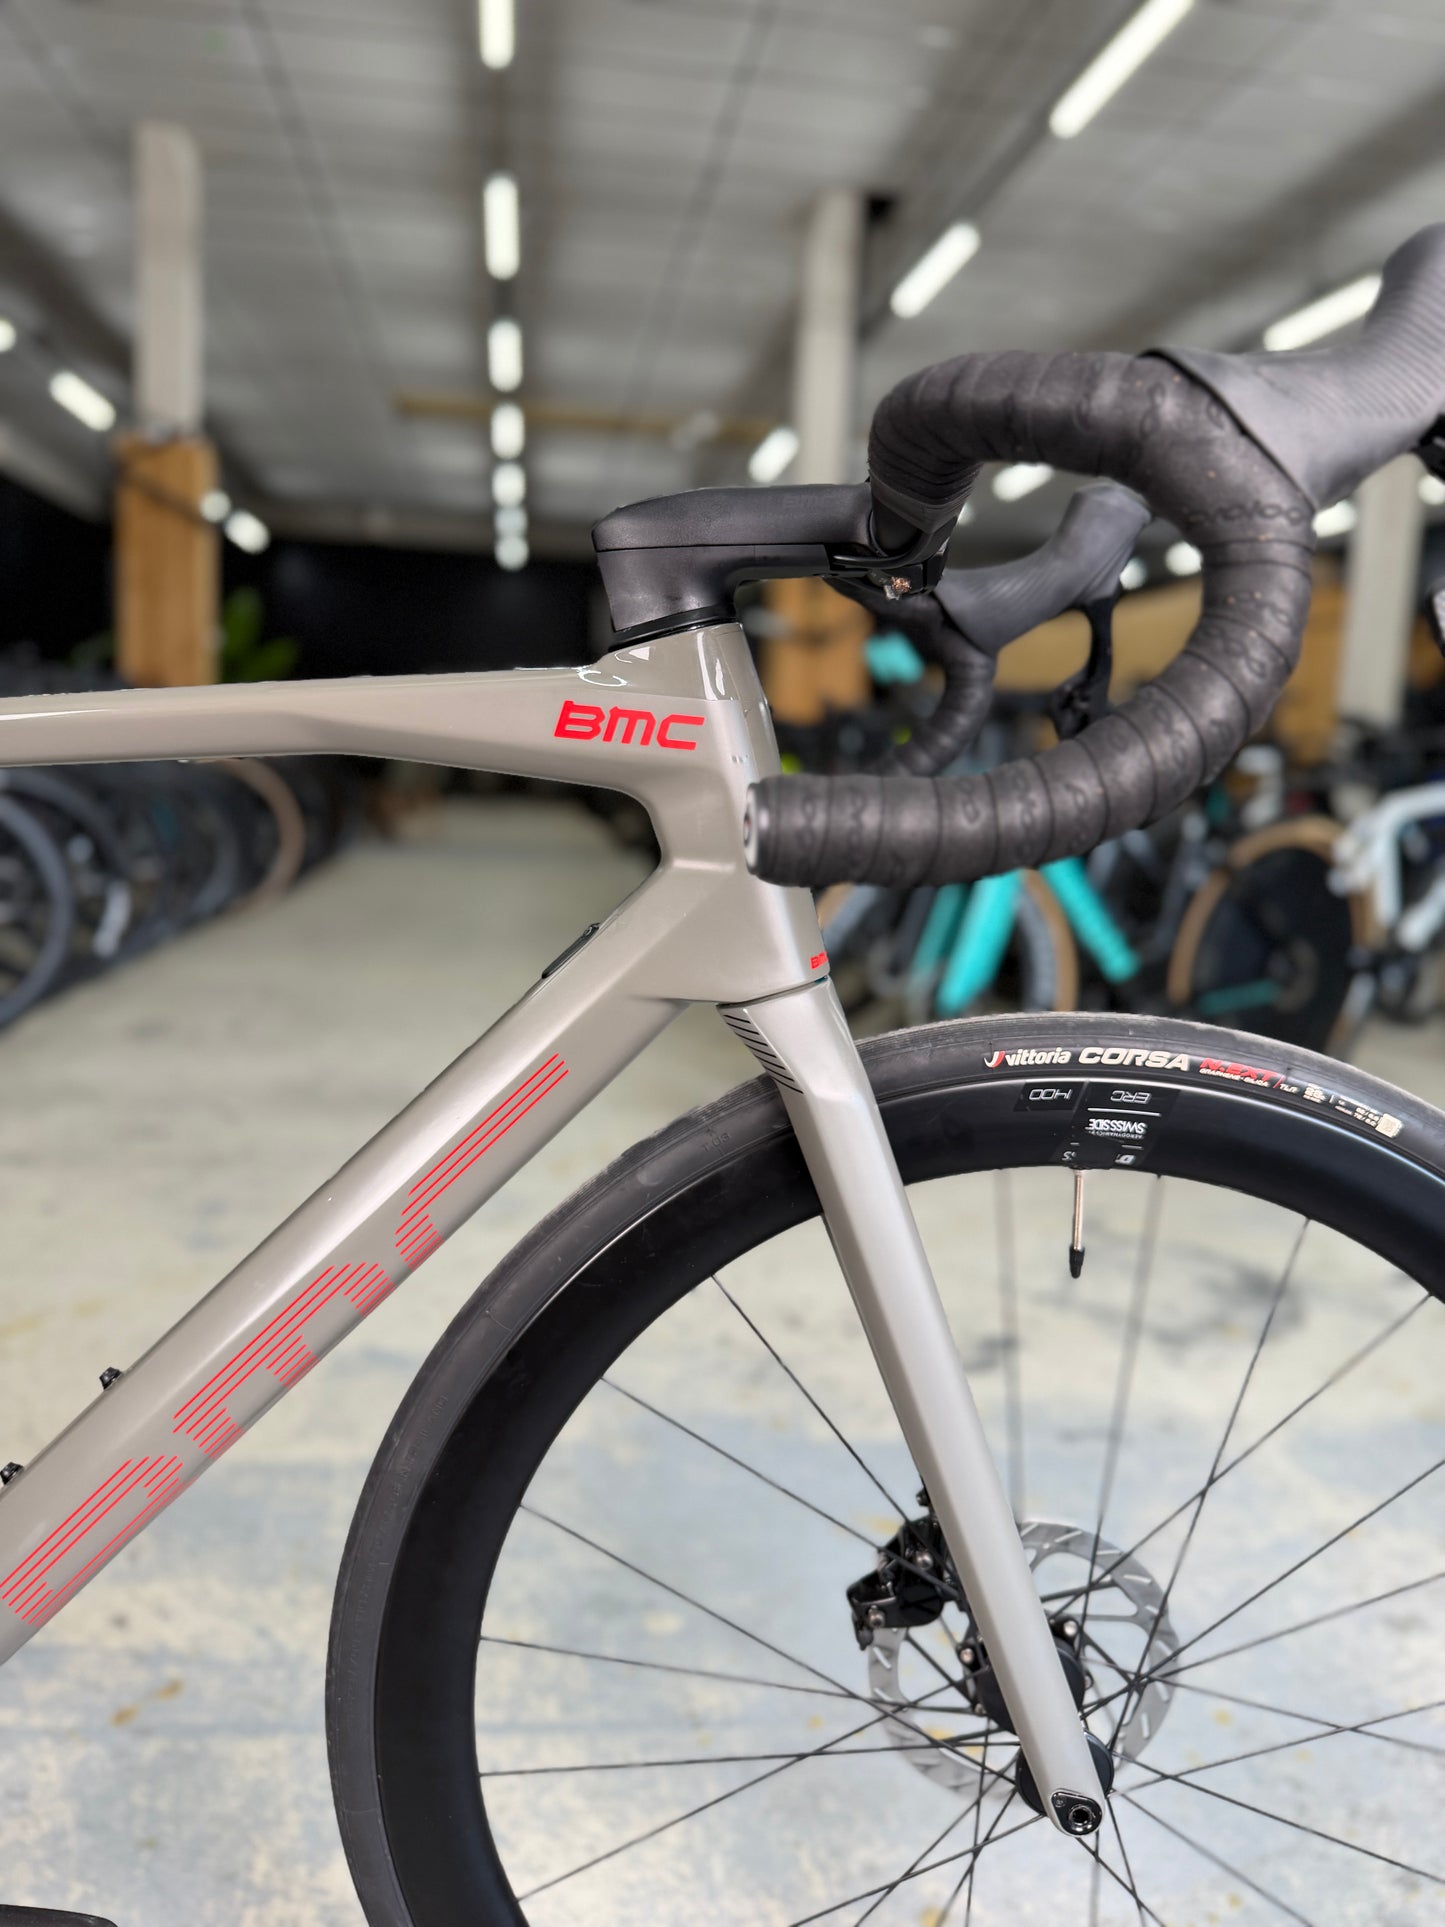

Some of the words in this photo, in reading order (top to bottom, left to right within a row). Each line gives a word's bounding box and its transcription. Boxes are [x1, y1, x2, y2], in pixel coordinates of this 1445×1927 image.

[554, 700, 705, 751] BMC
[1004, 1047, 1071, 1066] vittoria
[1078, 1047, 1191, 1071] CORSA
[1028, 1088, 1073, 1101] 1400
[1110, 1090, 1152, 1104] ERC
